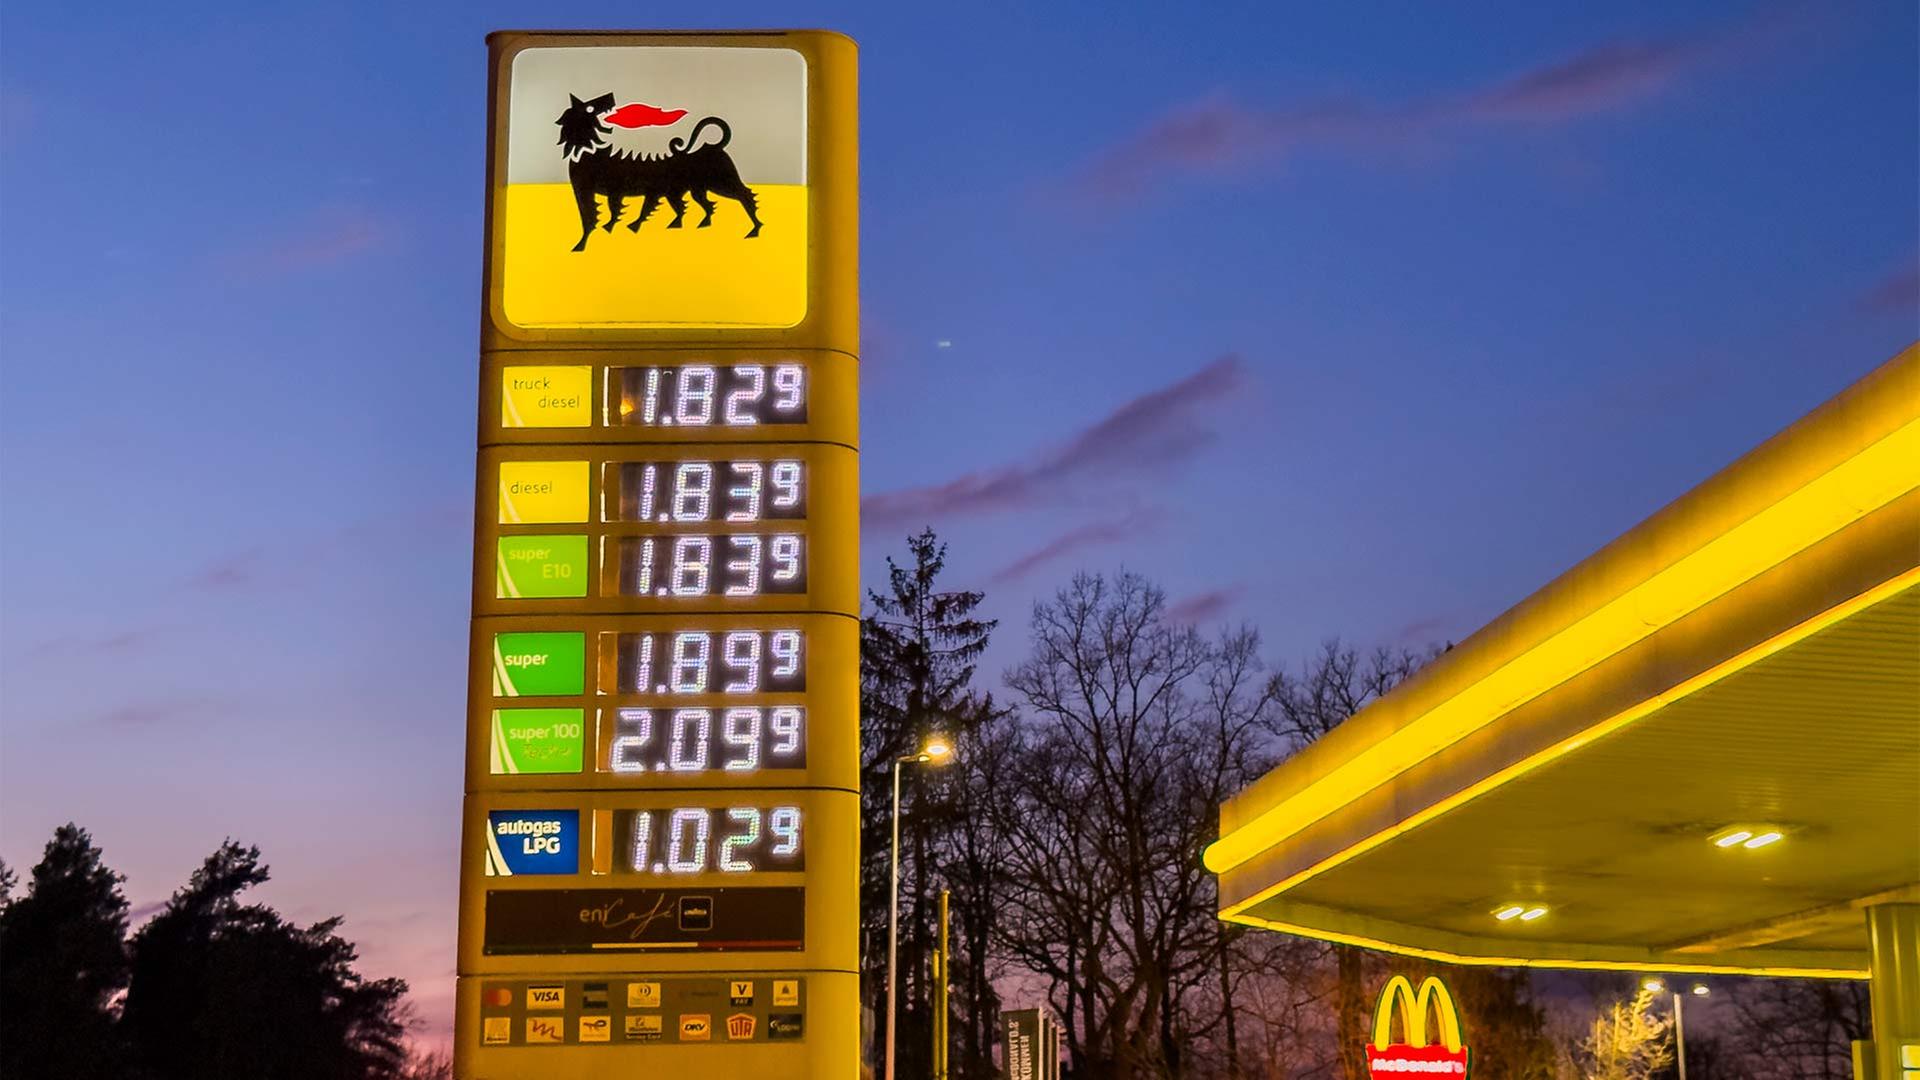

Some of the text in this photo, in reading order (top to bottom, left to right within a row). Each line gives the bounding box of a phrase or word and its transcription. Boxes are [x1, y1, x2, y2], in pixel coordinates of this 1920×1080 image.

[513, 377, 551, 390] truck
[538, 395, 580, 409] diesel
[510, 481, 552, 495] diesel
[508, 549, 551, 562] super
[542, 564, 571, 579] E10
[505, 653, 548, 668] super
[509, 723, 580, 741] super 100
[497, 820, 561, 838] autogas
[523, 837, 561, 855] LPG
[533, 991, 560, 1002] VISA
[737, 984, 747, 996] V
